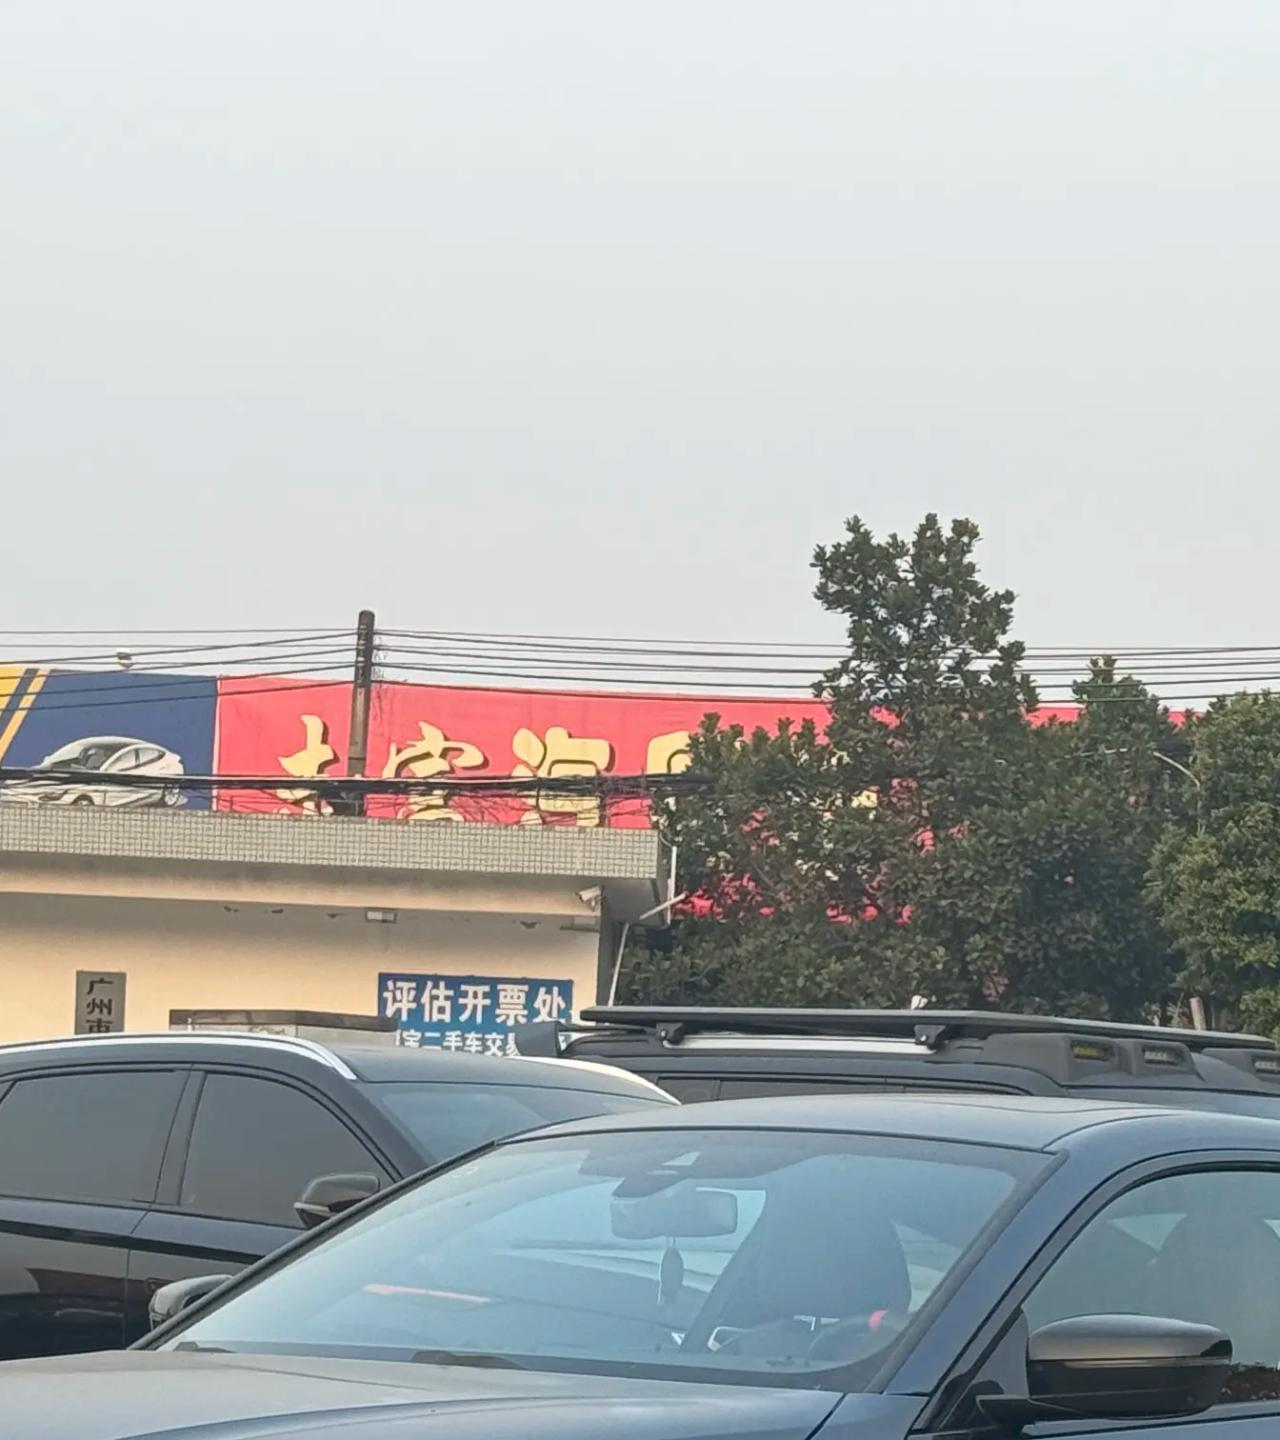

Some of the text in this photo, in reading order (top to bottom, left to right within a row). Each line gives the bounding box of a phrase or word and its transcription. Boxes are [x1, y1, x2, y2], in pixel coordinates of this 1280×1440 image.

[86, 977, 114, 1033] 广州市
[383, 979, 568, 1027] 评估开票处
